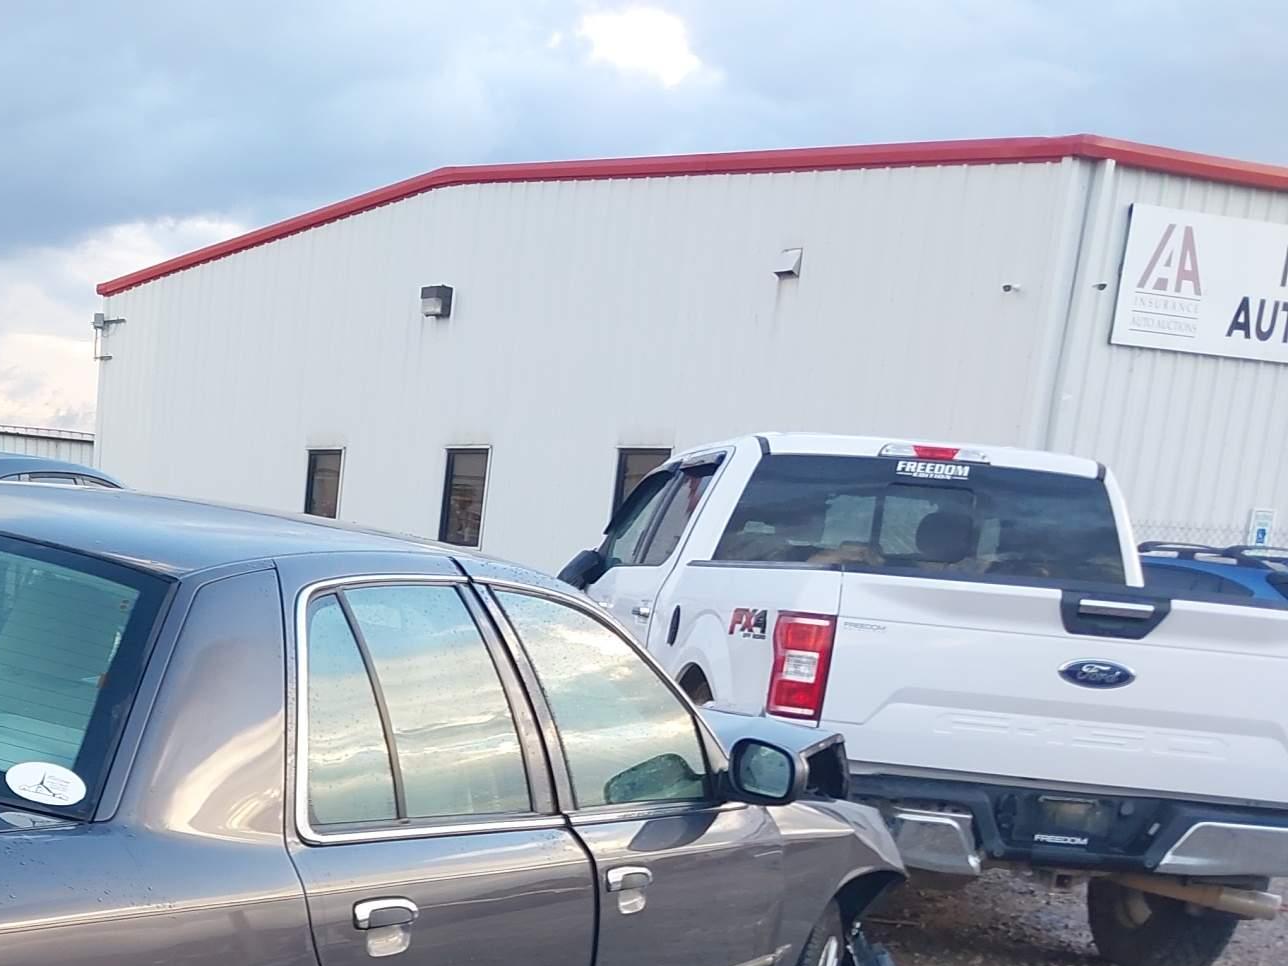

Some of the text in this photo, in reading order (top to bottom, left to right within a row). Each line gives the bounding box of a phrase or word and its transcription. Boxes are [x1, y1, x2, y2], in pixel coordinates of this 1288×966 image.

[896, 460, 970, 477] FREEDOM
[728, 607, 768, 635] FX4
[1076, 663, 1122, 683] Ford
[1034, 834, 1089, 846] FREEDOM
